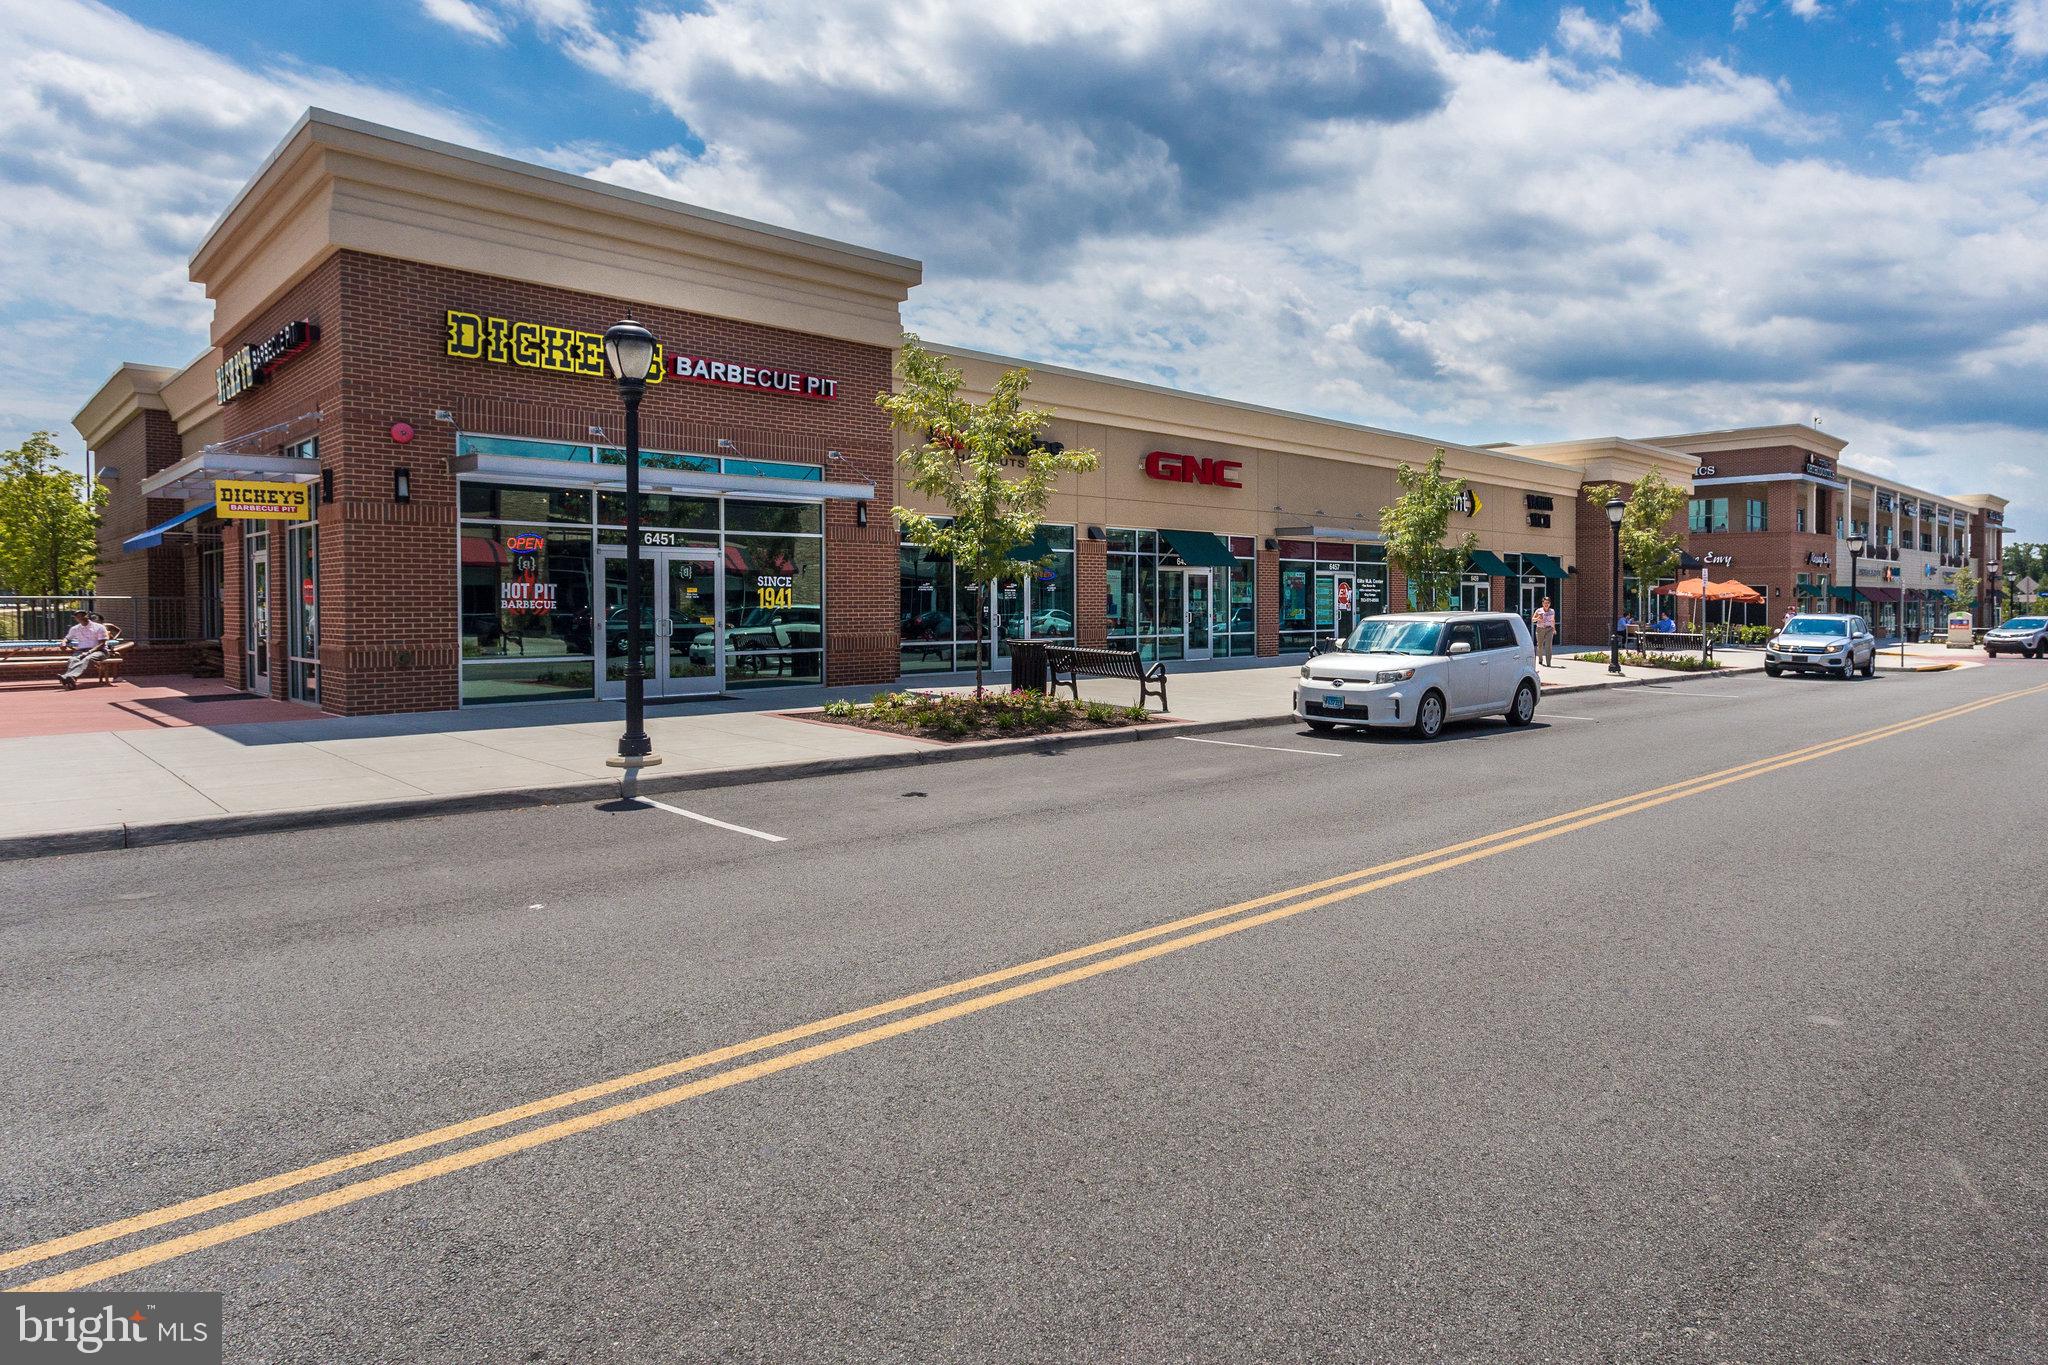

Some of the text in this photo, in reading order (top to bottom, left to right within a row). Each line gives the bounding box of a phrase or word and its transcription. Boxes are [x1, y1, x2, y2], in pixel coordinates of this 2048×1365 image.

[676, 355, 801, 392] BARBECUE
[807, 376, 838, 397] PIT
[1144, 451, 1243, 489] GNC
[230, 504, 297, 513] BARBECUE PIT
[506, 537, 545, 550] OPEN
[643, 532, 676, 546] 6451
[1703, 551, 1733, 568] Envy
[757, 575, 793, 588] SINCE
[501, 582, 558, 600] HOT PIT
[757, 587, 793, 610] 1941
[500, 600, 558, 610] BARBECUE
